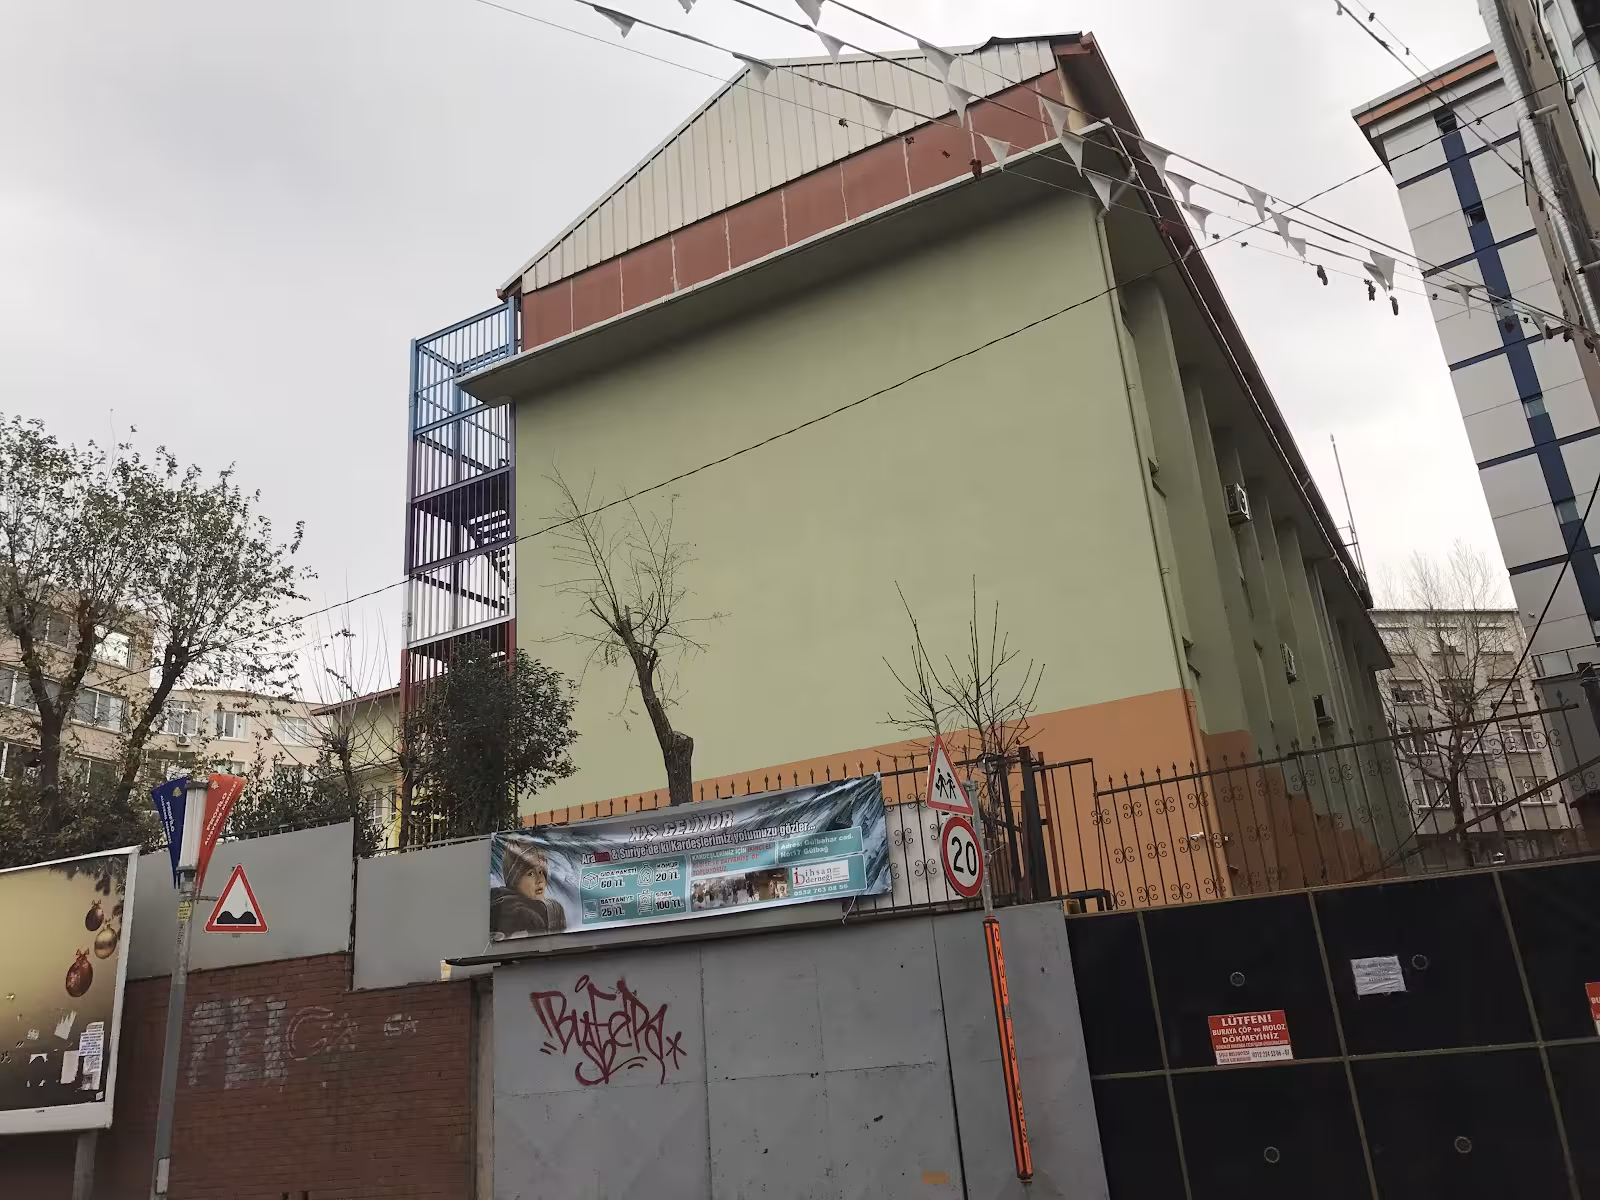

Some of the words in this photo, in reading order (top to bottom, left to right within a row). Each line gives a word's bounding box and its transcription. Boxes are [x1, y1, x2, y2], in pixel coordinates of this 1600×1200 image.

[611, 849, 620, 860] &
[734, 827, 777, 843] yolumuzu
[951, 836, 977, 876] 20
[655, 872, 667, 881] 20
[805, 868, 832, 877] ihsan
[655, 899, 669, 910] 100
[601, 907, 612, 917] 25
[1221, 1014, 1272, 1027] LÜTFEN!
[1212, 1028, 1237, 1036] BURAYA
[1238, 1026, 1252, 1035] ÇÖP
[1262, 1023, 1286, 1032] MOLOZ
[1222, 1032, 1280, 1044] DÖKMEYİNİZ
